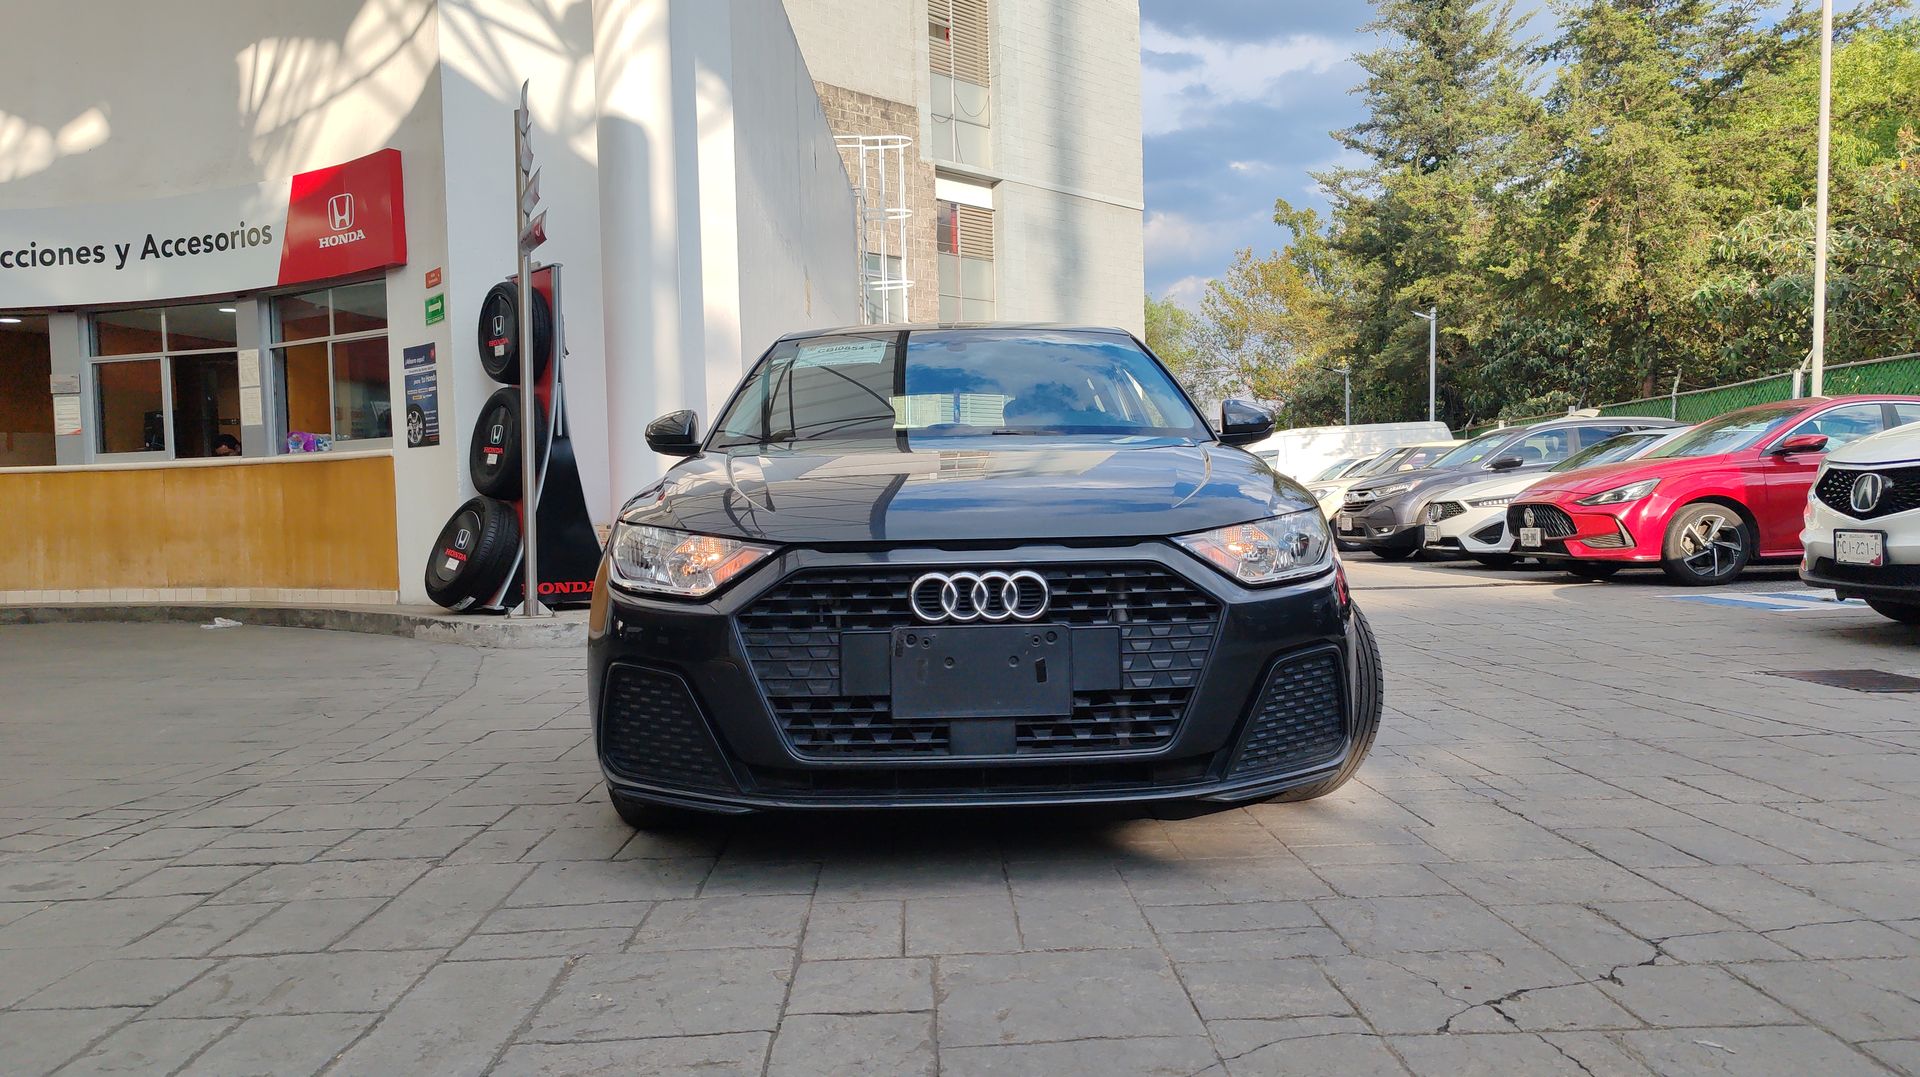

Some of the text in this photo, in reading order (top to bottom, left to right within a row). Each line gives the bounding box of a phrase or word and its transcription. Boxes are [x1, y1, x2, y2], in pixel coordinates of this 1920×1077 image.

[0, 220, 273, 270] cciones y Accesorios
[319, 229, 366, 249] HONDA
[445, 548, 467, 561] HONDA
[521, 580, 595, 595] ONDA
